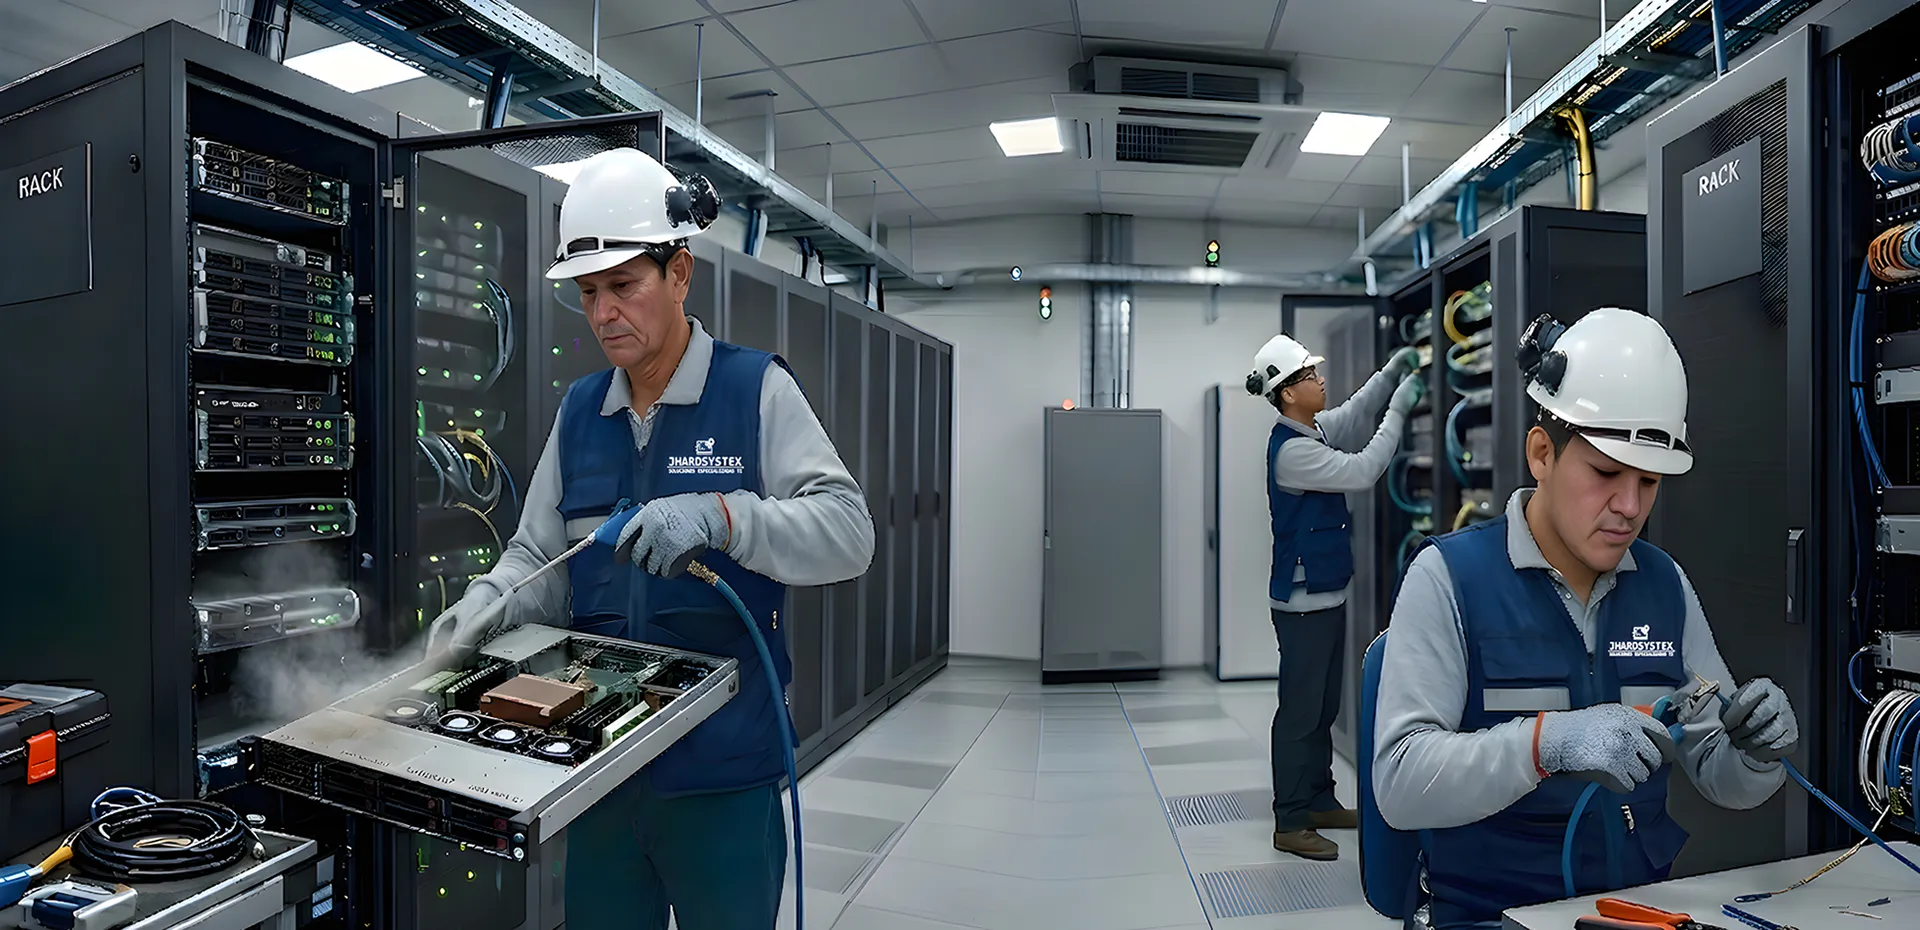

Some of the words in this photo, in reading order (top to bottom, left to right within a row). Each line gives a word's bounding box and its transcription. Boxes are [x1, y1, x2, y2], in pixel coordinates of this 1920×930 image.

[19, 167, 63, 199] RACK
[1699, 159, 1740, 196] RACK
[668, 456, 742, 467] JHARDSYSTEX
[1609, 641, 1674, 651] JHARDSYSTEX
